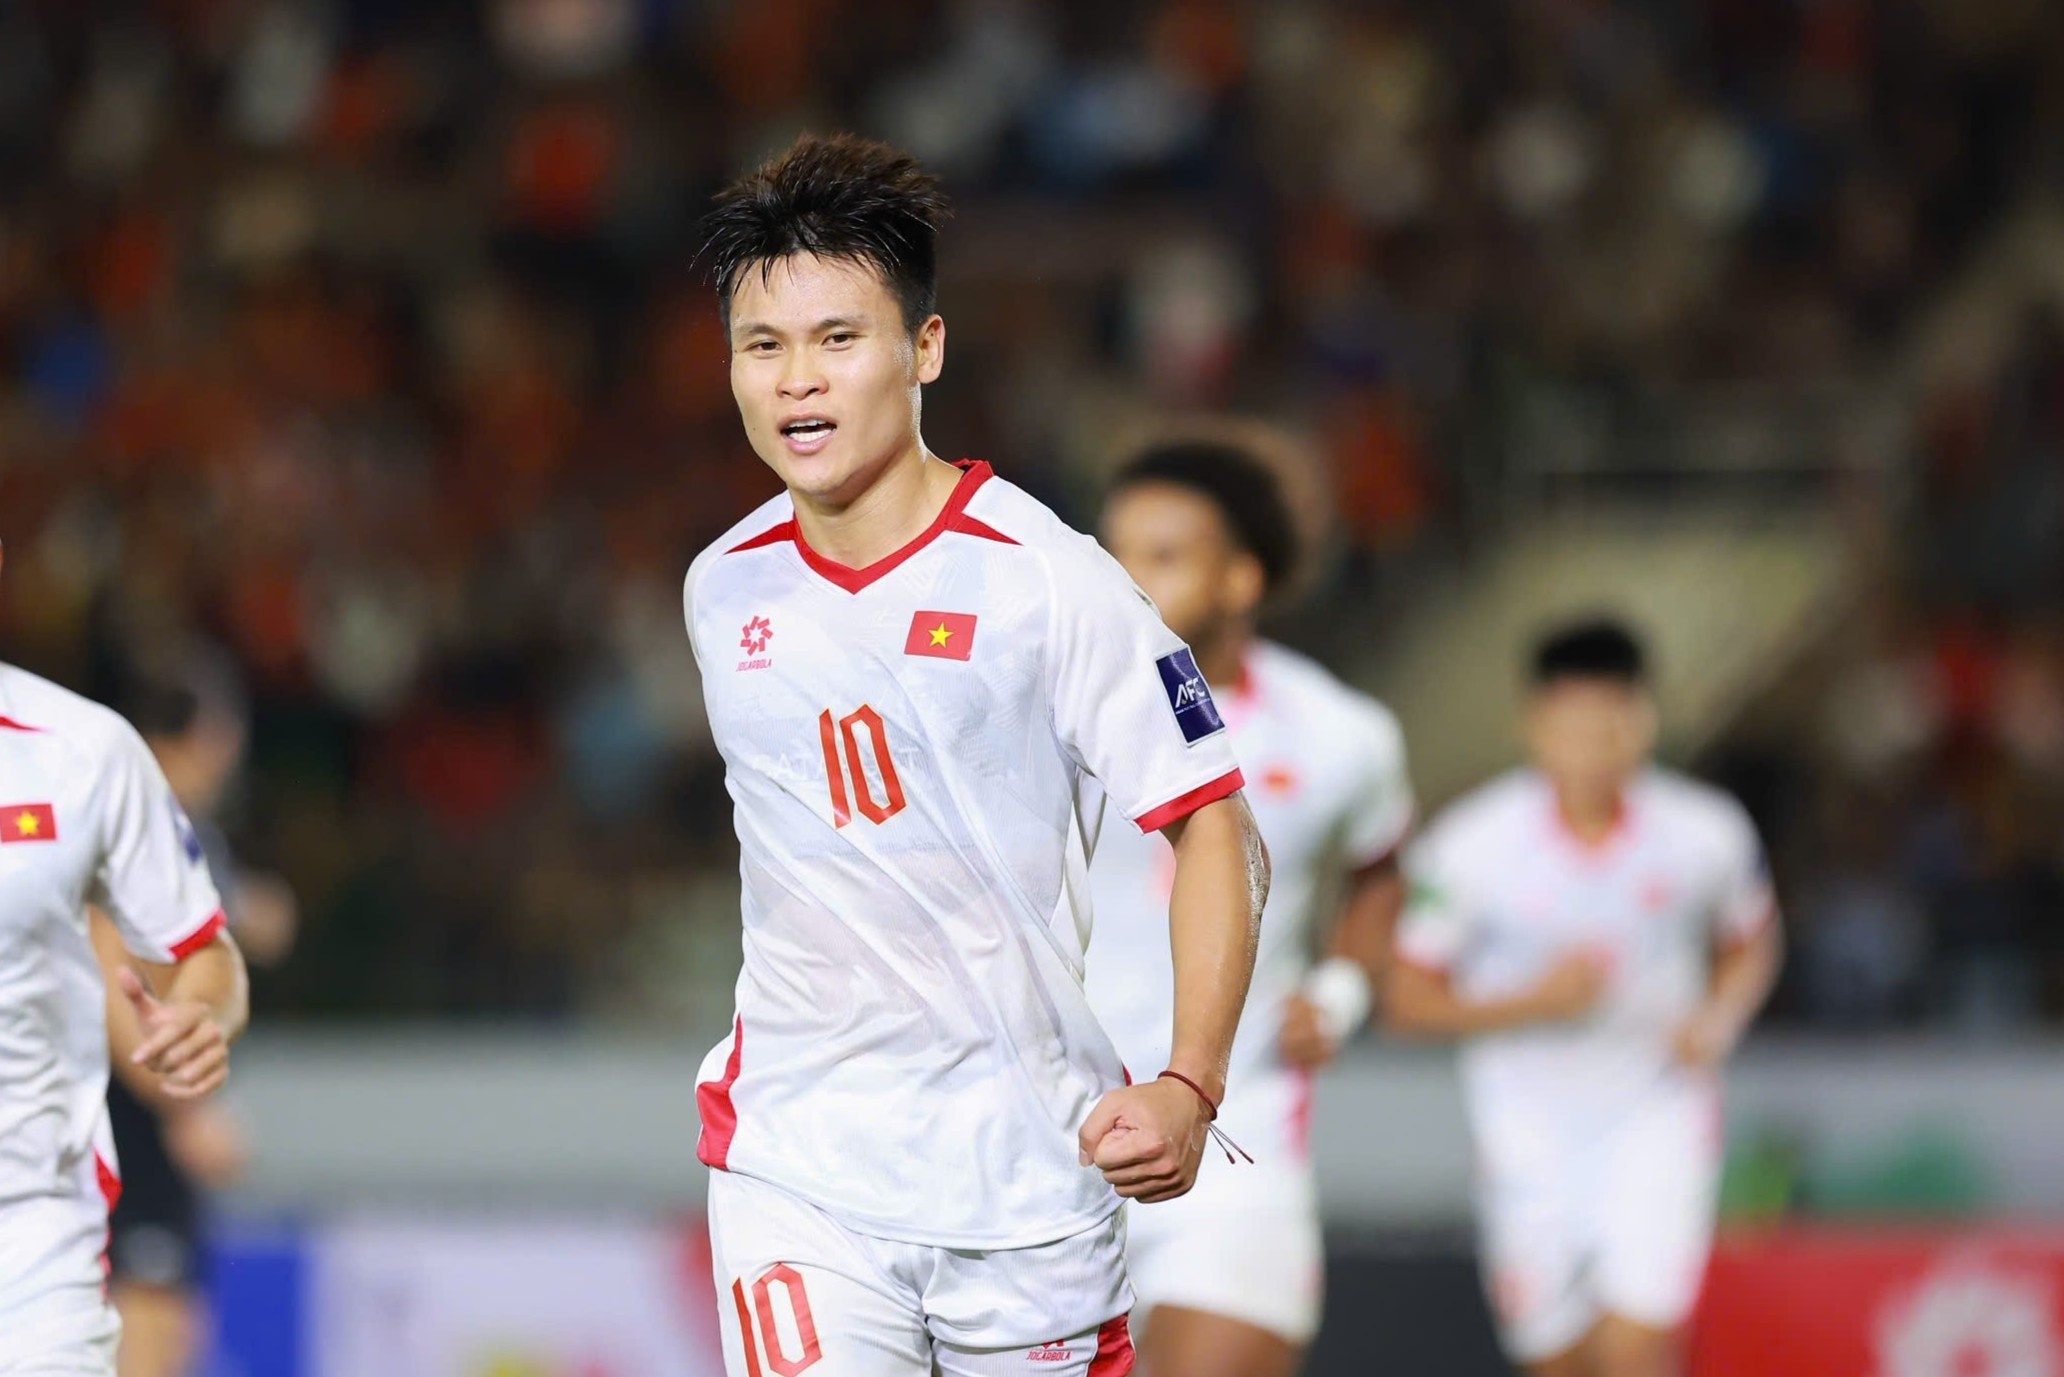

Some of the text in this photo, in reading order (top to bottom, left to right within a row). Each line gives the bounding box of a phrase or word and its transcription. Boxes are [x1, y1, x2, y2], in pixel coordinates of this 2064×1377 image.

[1175, 676, 1206, 708] AFC
[818, 702, 908, 830] 10
[732, 1261, 823, 1377] 10
